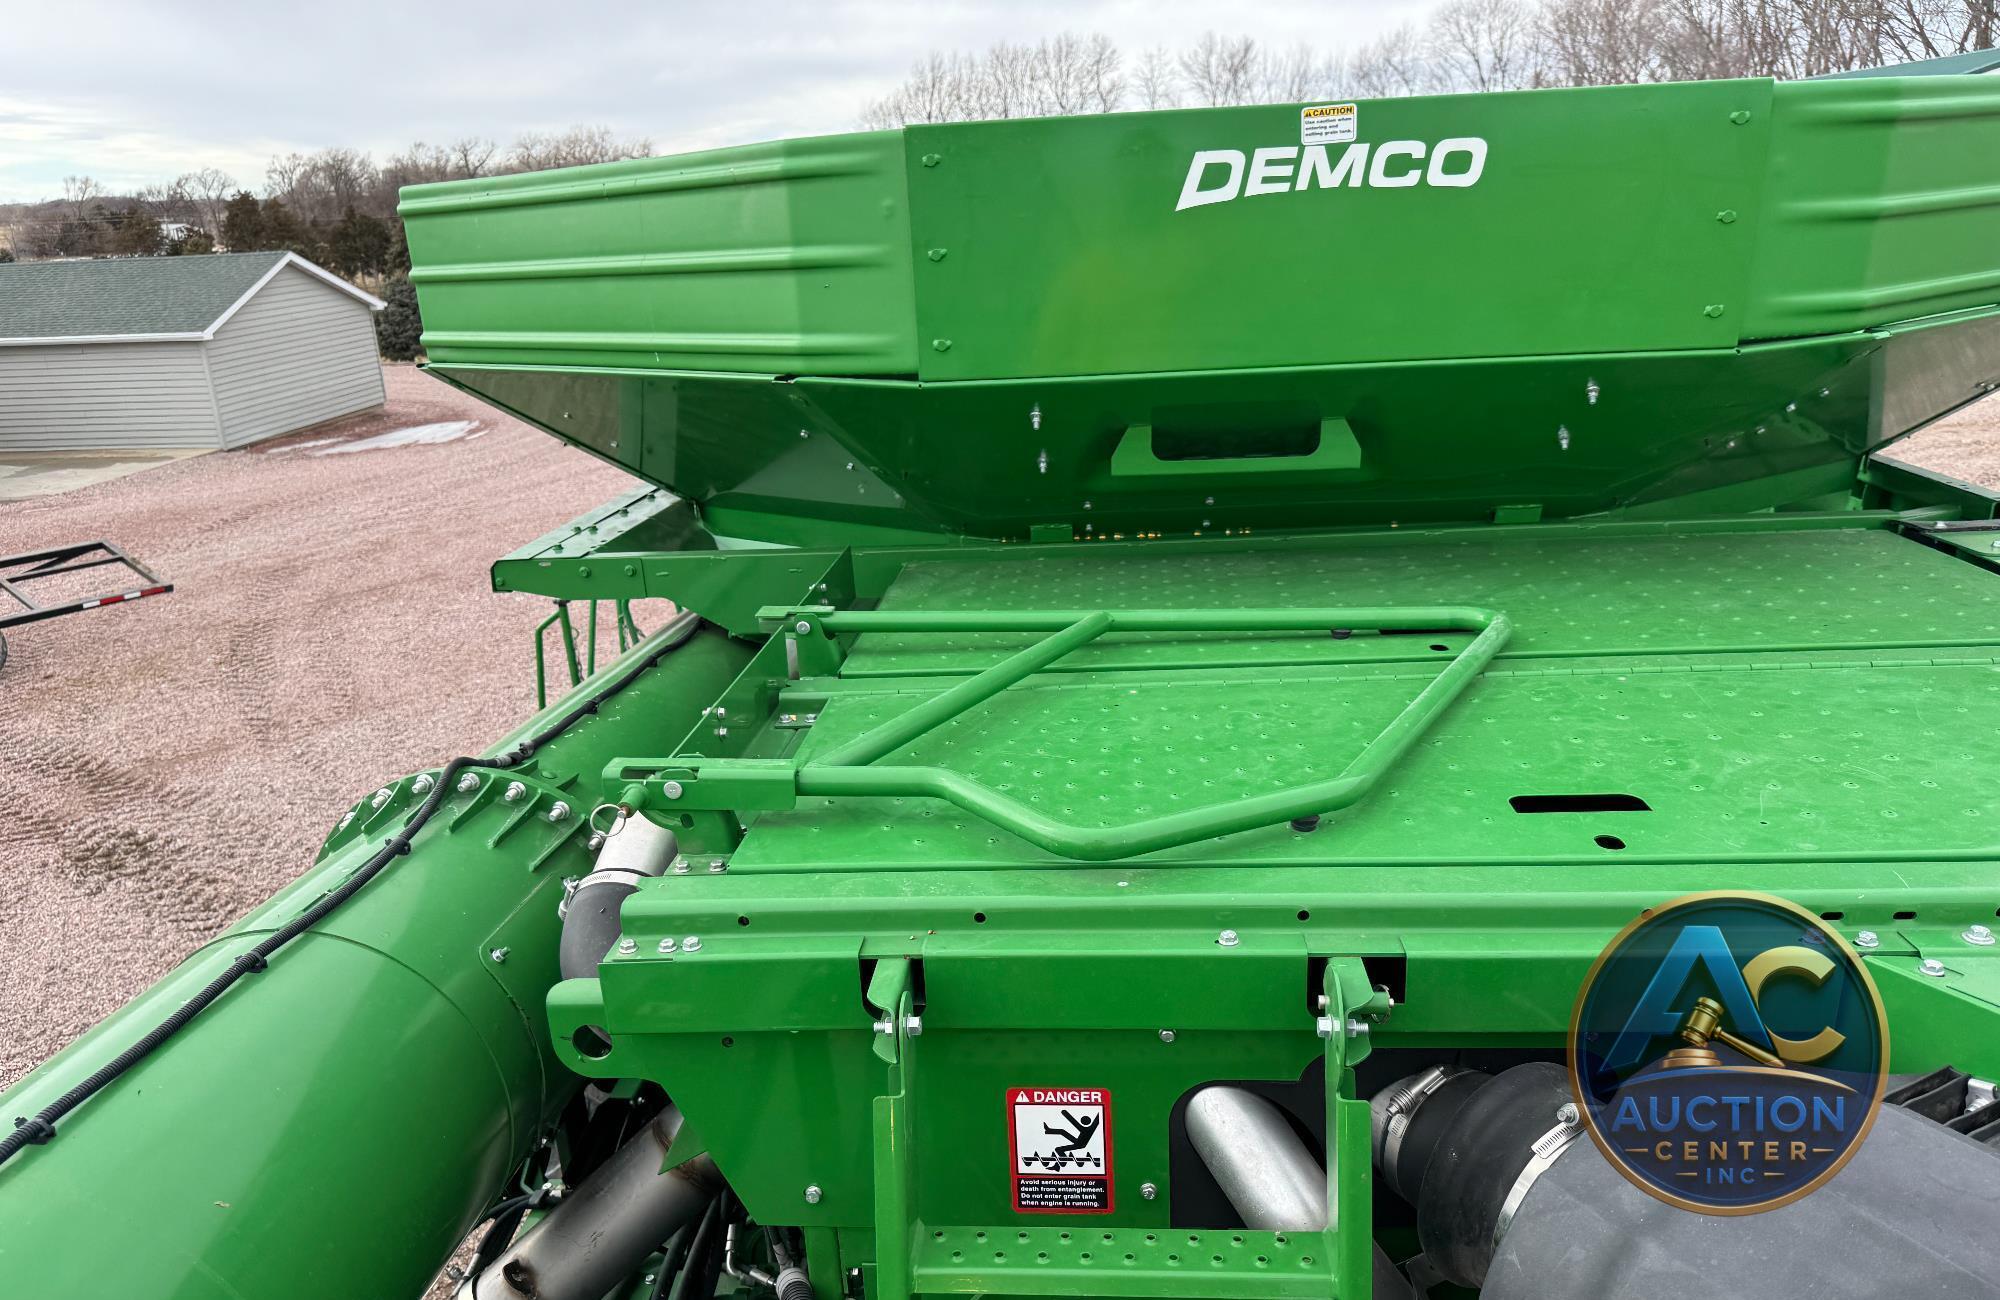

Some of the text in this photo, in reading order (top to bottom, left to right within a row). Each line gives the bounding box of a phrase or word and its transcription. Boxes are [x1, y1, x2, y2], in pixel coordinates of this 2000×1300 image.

[1313, 107, 1353, 116] CAUTION
[1175, 137, 1488, 211] DEMCO
[1033, 1091, 1102, 1103] DANGER
